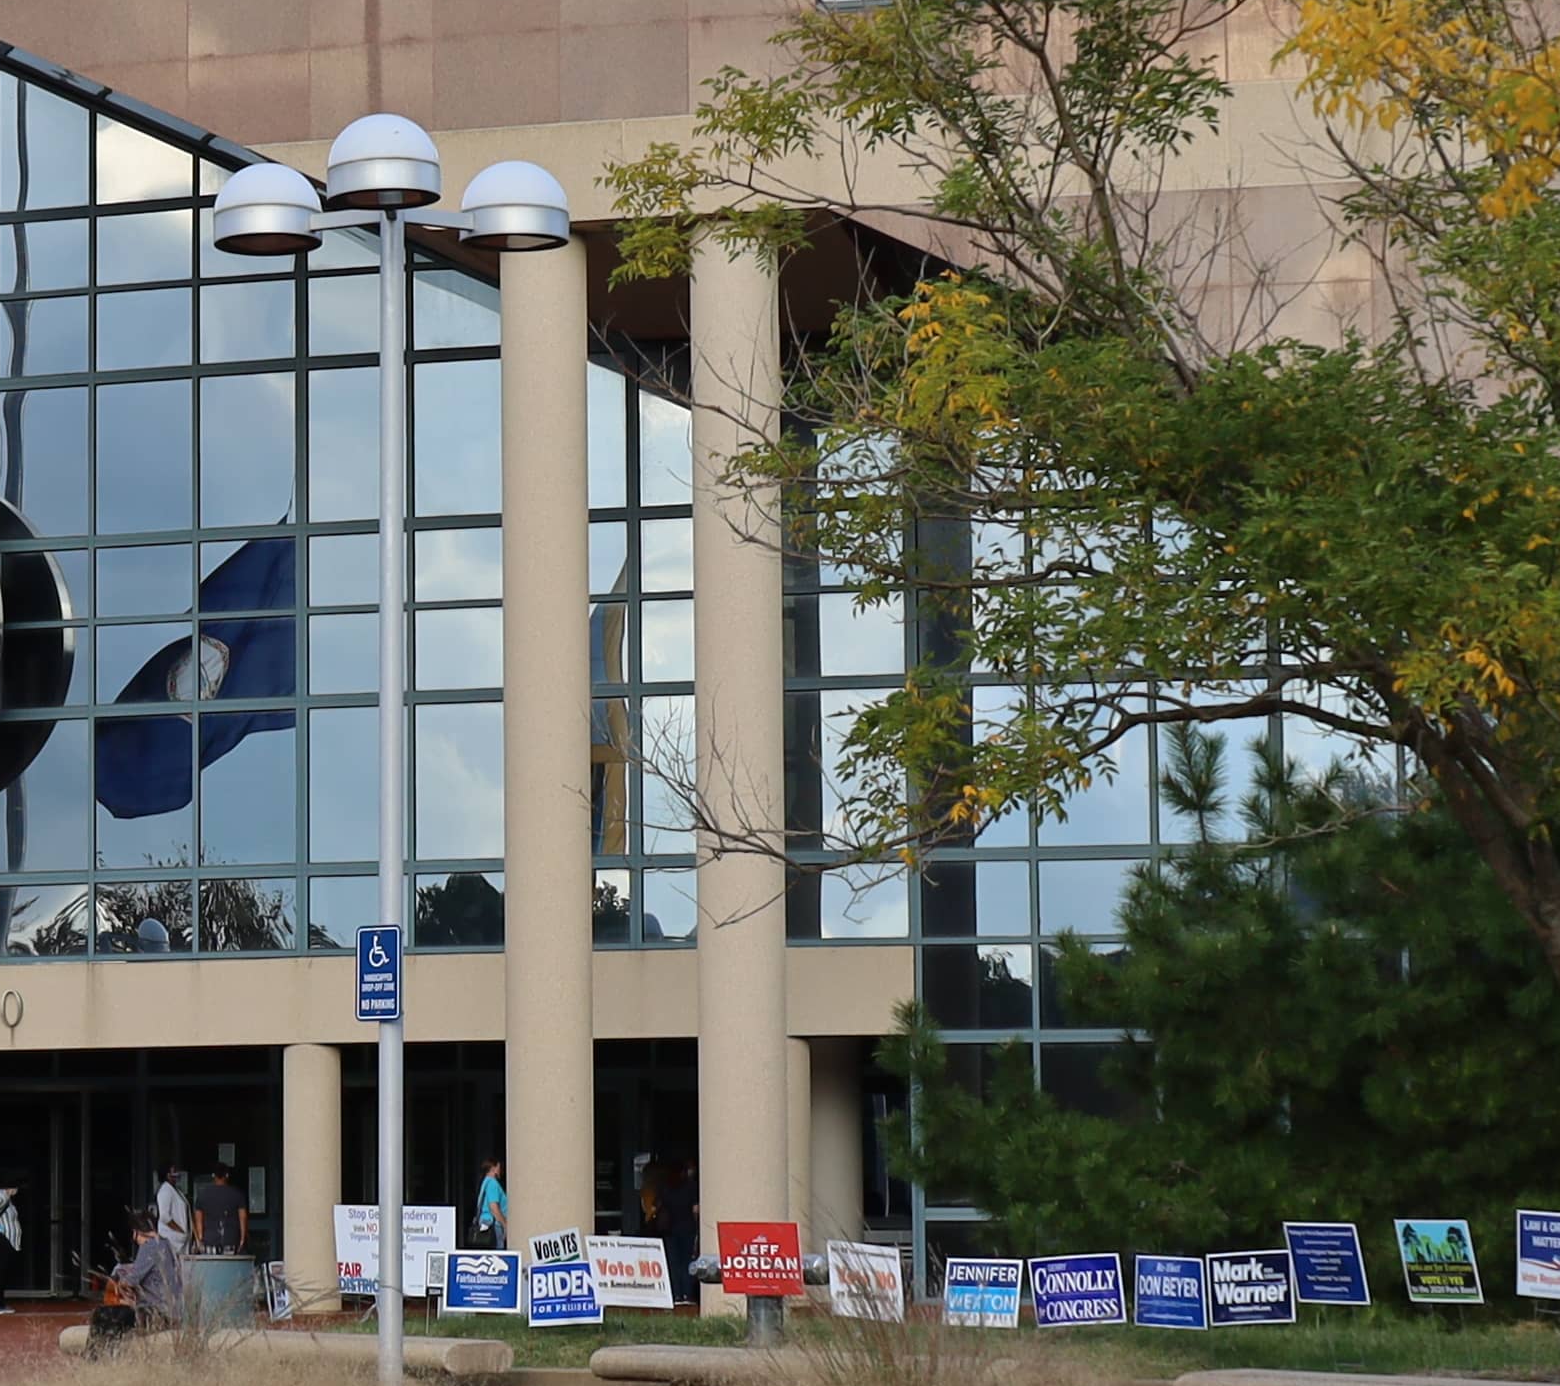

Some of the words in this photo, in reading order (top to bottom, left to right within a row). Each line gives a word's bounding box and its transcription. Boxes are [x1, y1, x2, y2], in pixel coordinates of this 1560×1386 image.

[361, 999, 370, 1010] NO
[370, 998, 395, 1010] PARKING
[348, 1208, 367, 1221] Stop
[366, 1223, 377, 1233] NO
[1523, 1219, 1541, 1232] LAW
[534, 1241, 560, 1260] Vote
[560, 1233, 578, 1254] YES
[740, 1244, 779, 1255] JEFF
[337, 1262, 362, 1277] FAIR
[596, 1258, 635, 1276] Vote
[638, 1260, 663, 1278] NO
[723, 1256, 798, 1270] JORDAN
[1212, 1257, 1263, 1282] Mark
[747, 1271, 801, 1280] CONGRESS
[949, 1264, 1017, 1283] JENNIFER
[1420, 1276, 1441, 1285] VOTE
[1447, 1276, 1464, 1286] YES
[339, 1278, 379, 1293] DISTRIC
[1034, 1268, 1115, 1295] CONNOLLY
[1139, 1274, 1162, 1296] DON
[1163, 1276, 1199, 1299] BEYER
[948, 1292, 1016, 1311] WEXTON
[1213, 1283, 1288, 1305] Warner
[533, 1303, 552, 1314] FOR
[1046, 1297, 1119, 1322] CONGRESS
